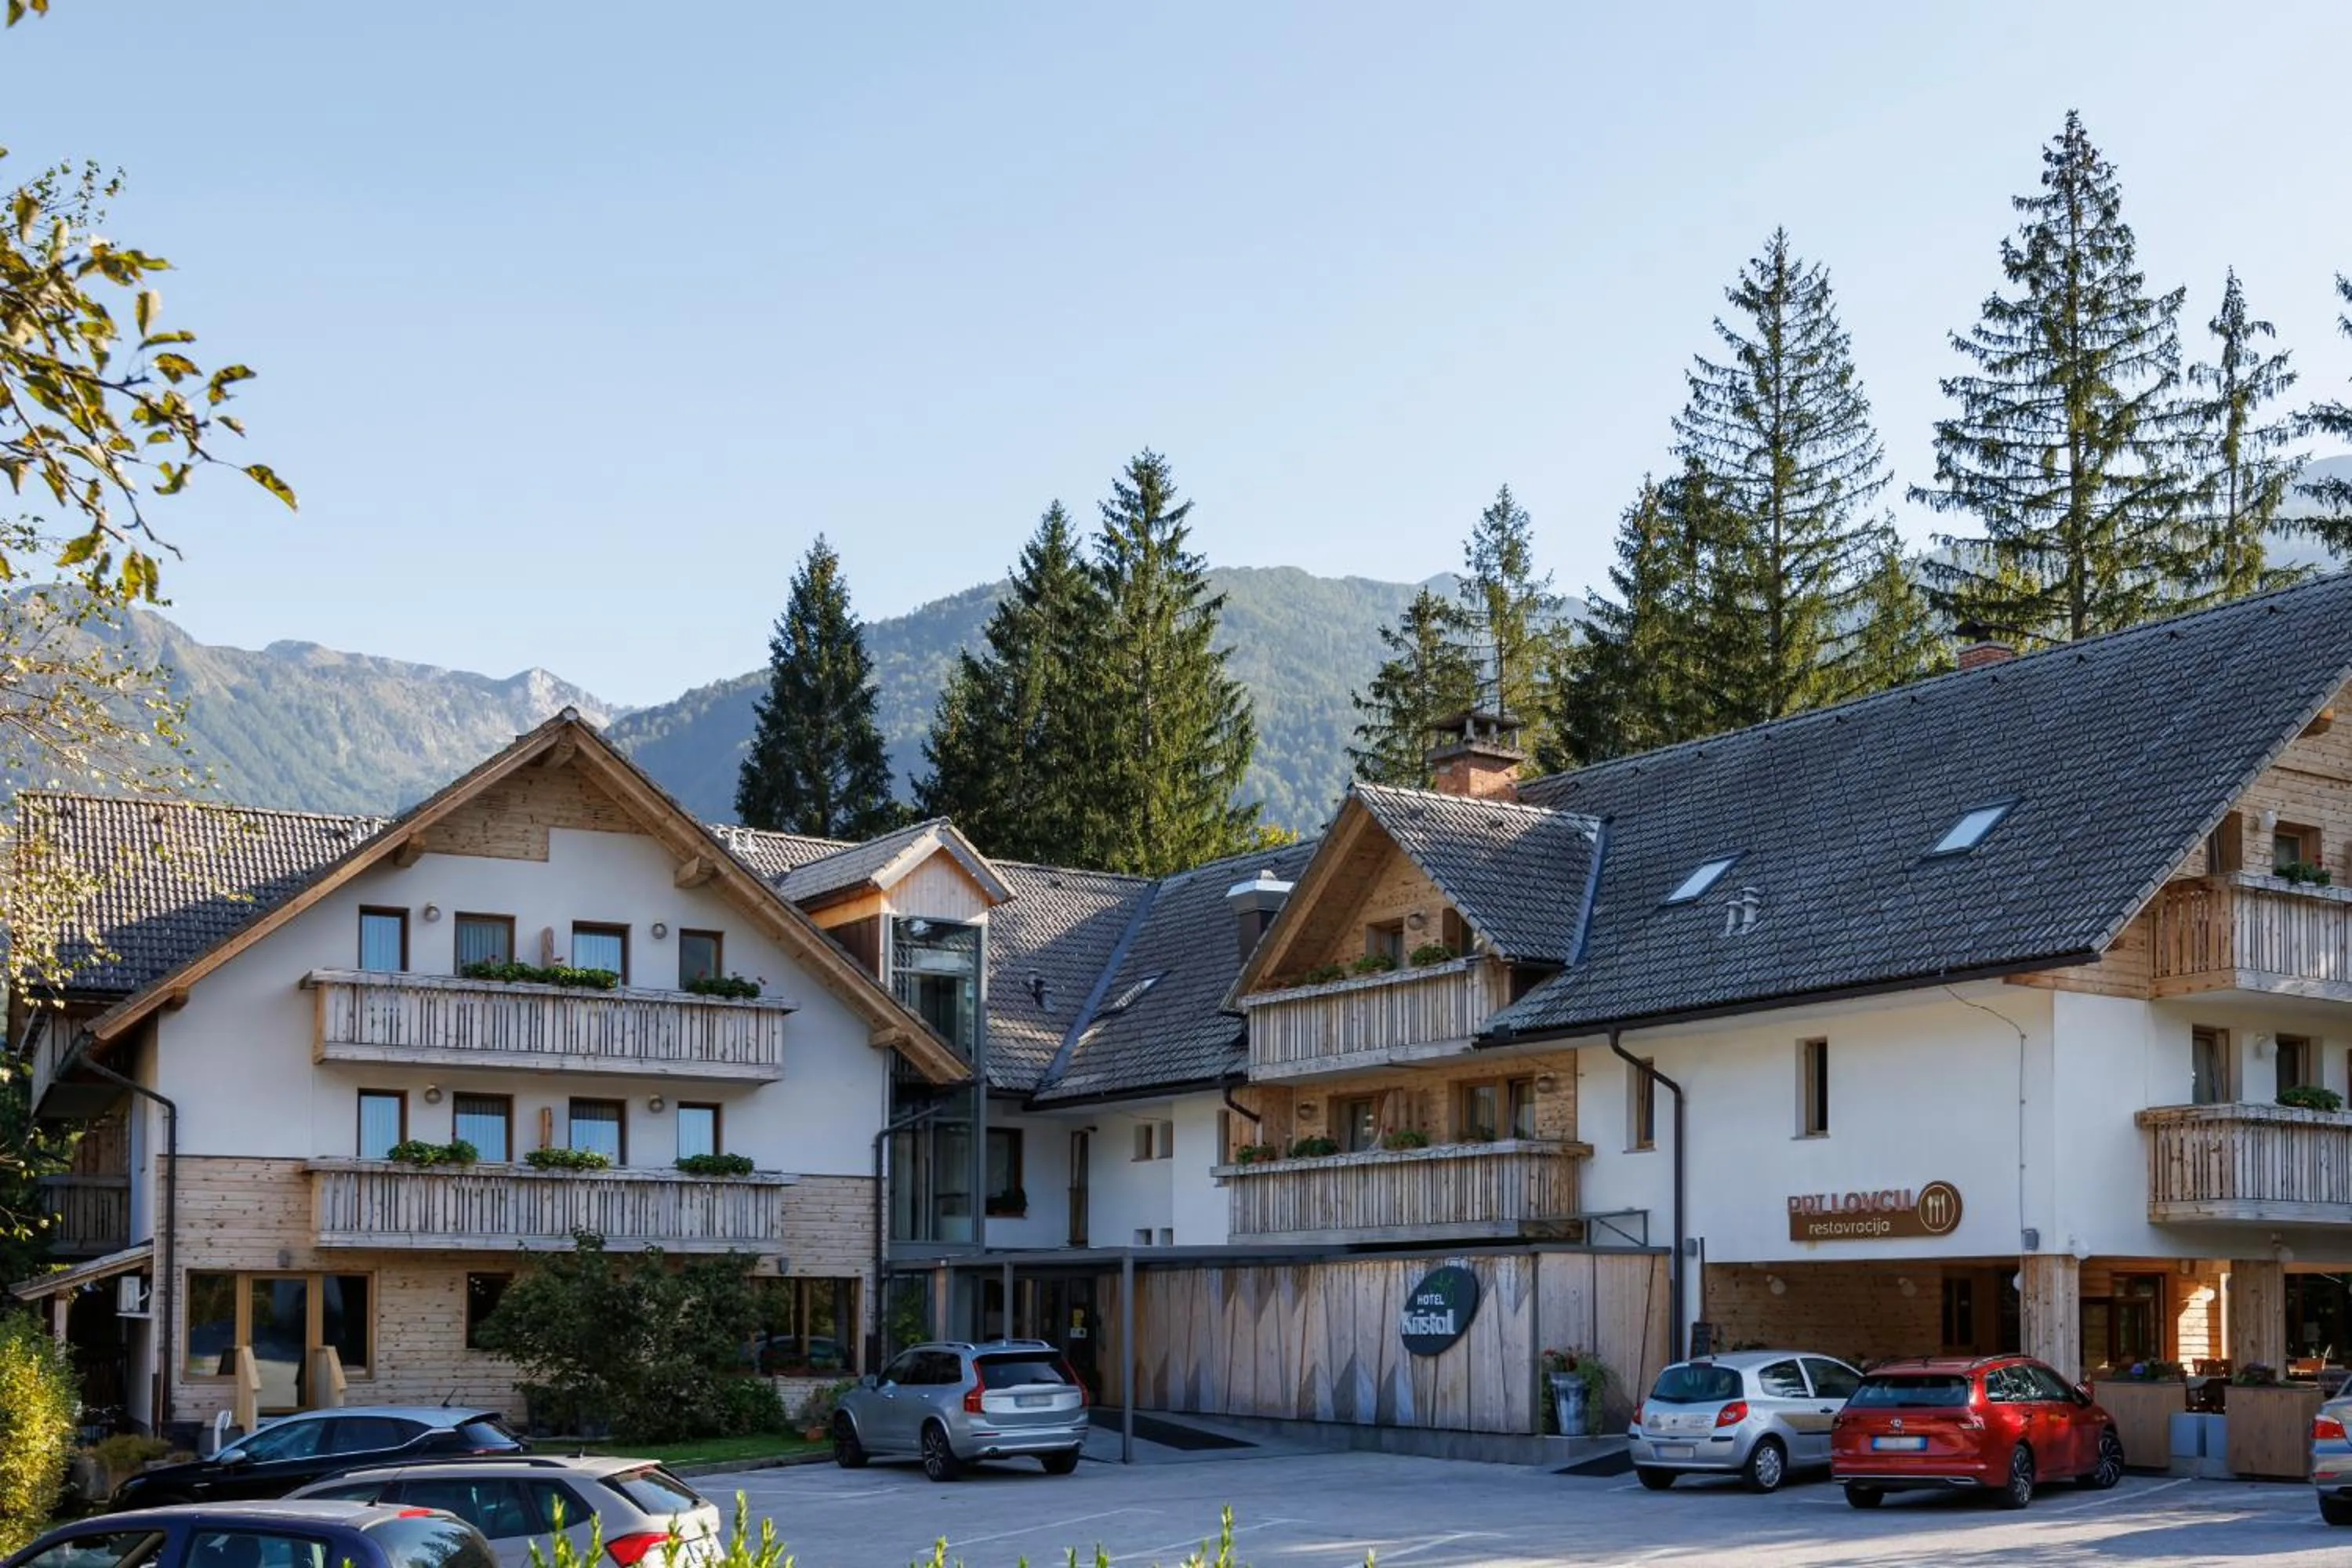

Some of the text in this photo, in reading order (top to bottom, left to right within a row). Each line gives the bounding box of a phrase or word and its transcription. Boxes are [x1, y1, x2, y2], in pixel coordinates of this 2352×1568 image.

[1788, 1189, 1911, 1215] PRI LOVCU
[1809, 1218, 1890, 1235] restavracija
[1417, 1294, 1445, 1305] HOTEL
[1401, 1308, 1456, 1335] Kristal
